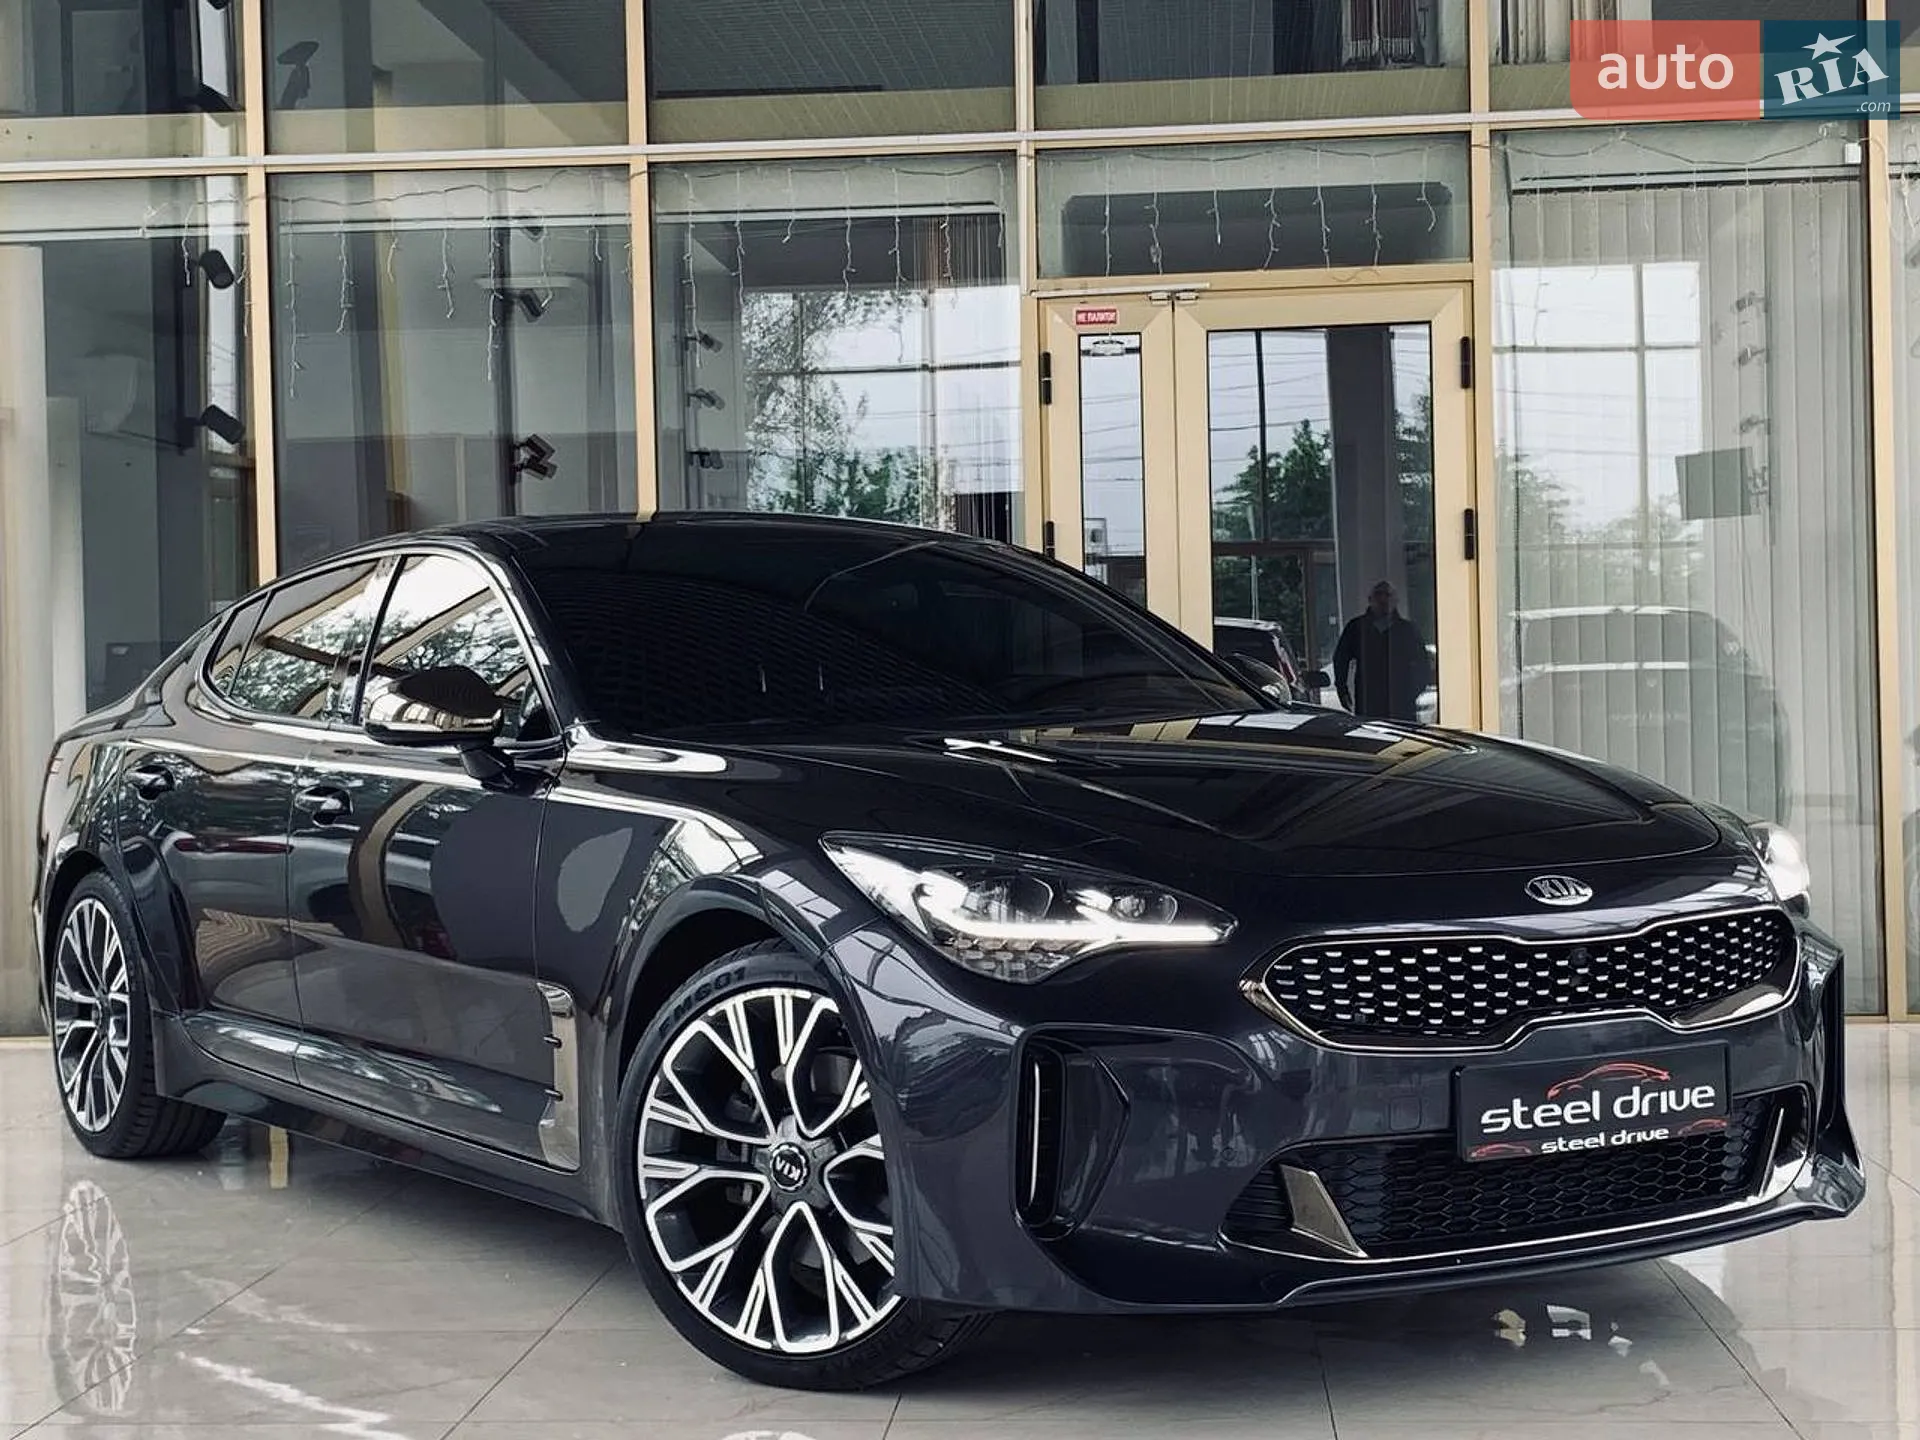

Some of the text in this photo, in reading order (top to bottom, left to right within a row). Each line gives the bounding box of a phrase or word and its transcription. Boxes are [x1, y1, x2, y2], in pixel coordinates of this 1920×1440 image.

[1532, 878, 1588, 899] KIA
[1480, 1084, 1716, 1134] steel drive
[1540, 1126, 1669, 1155] steel drive
